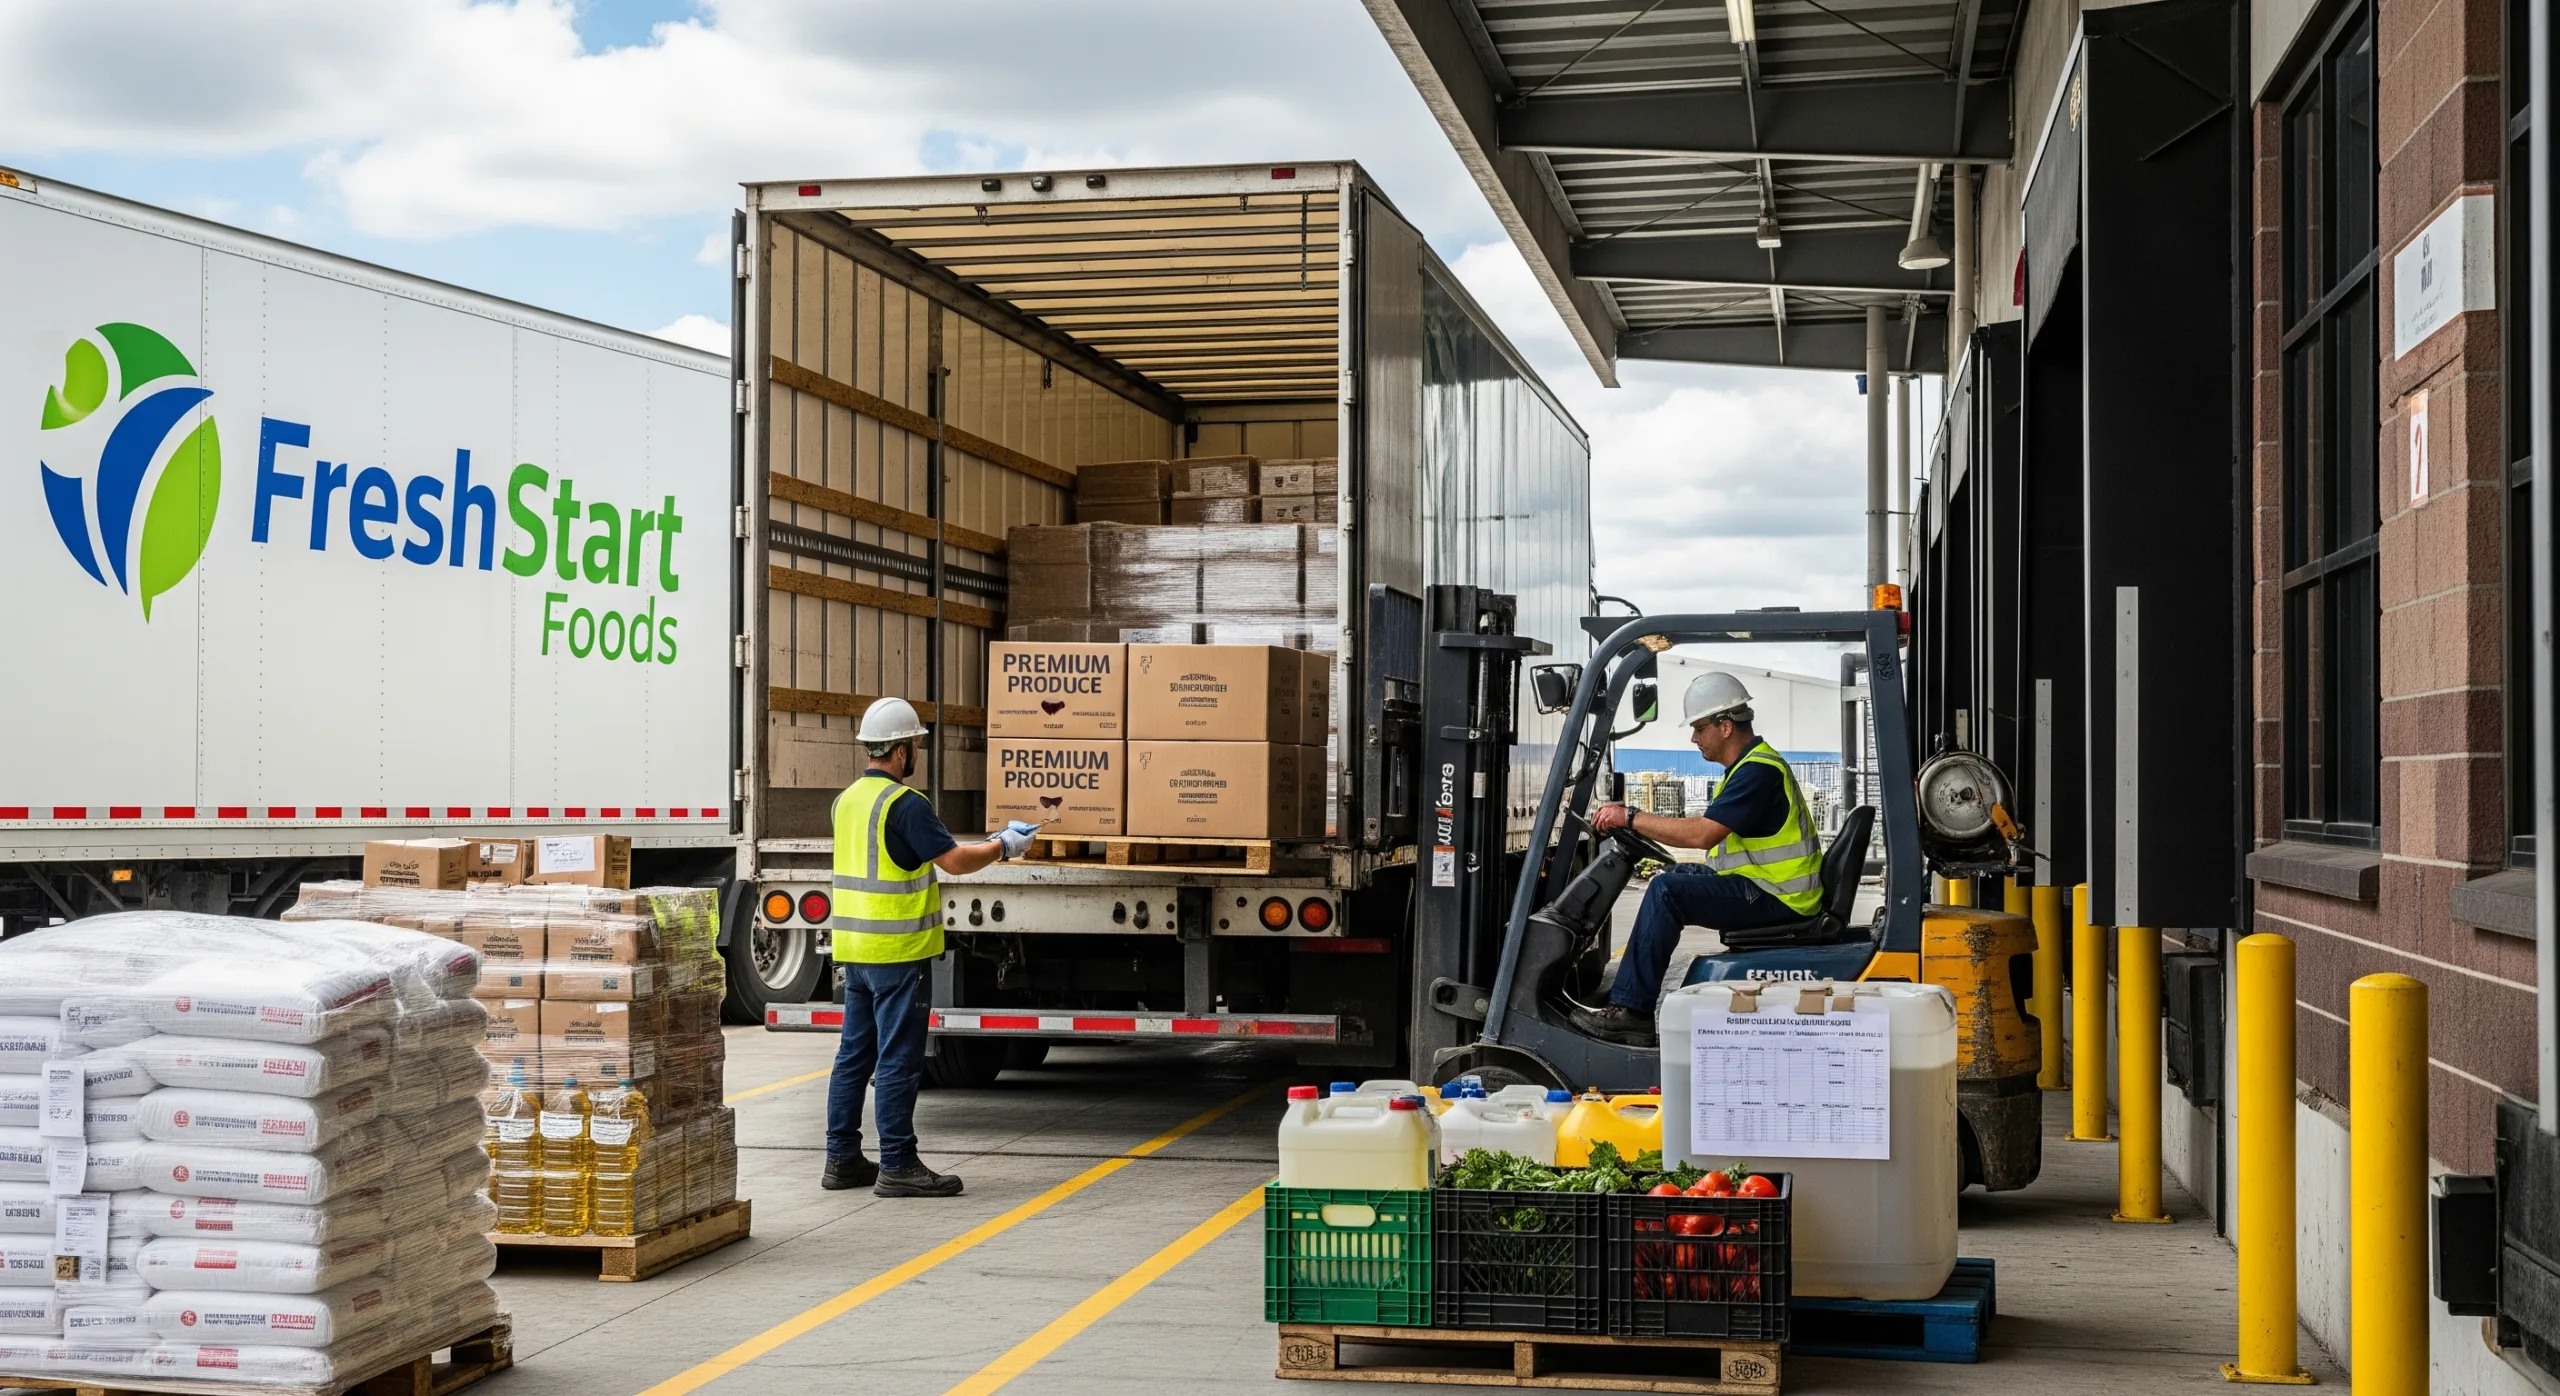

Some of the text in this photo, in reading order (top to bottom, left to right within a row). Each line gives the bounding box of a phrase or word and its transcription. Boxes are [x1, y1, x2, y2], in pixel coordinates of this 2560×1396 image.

[541, 591, 678, 665] Foods
[1003, 653, 1111, 674] PREMIUM
[1008, 675, 1102, 694] PRODUCE
[1001, 748, 1109, 771] PREMIUM
[1004, 770, 1100, 790] PRODUCE
